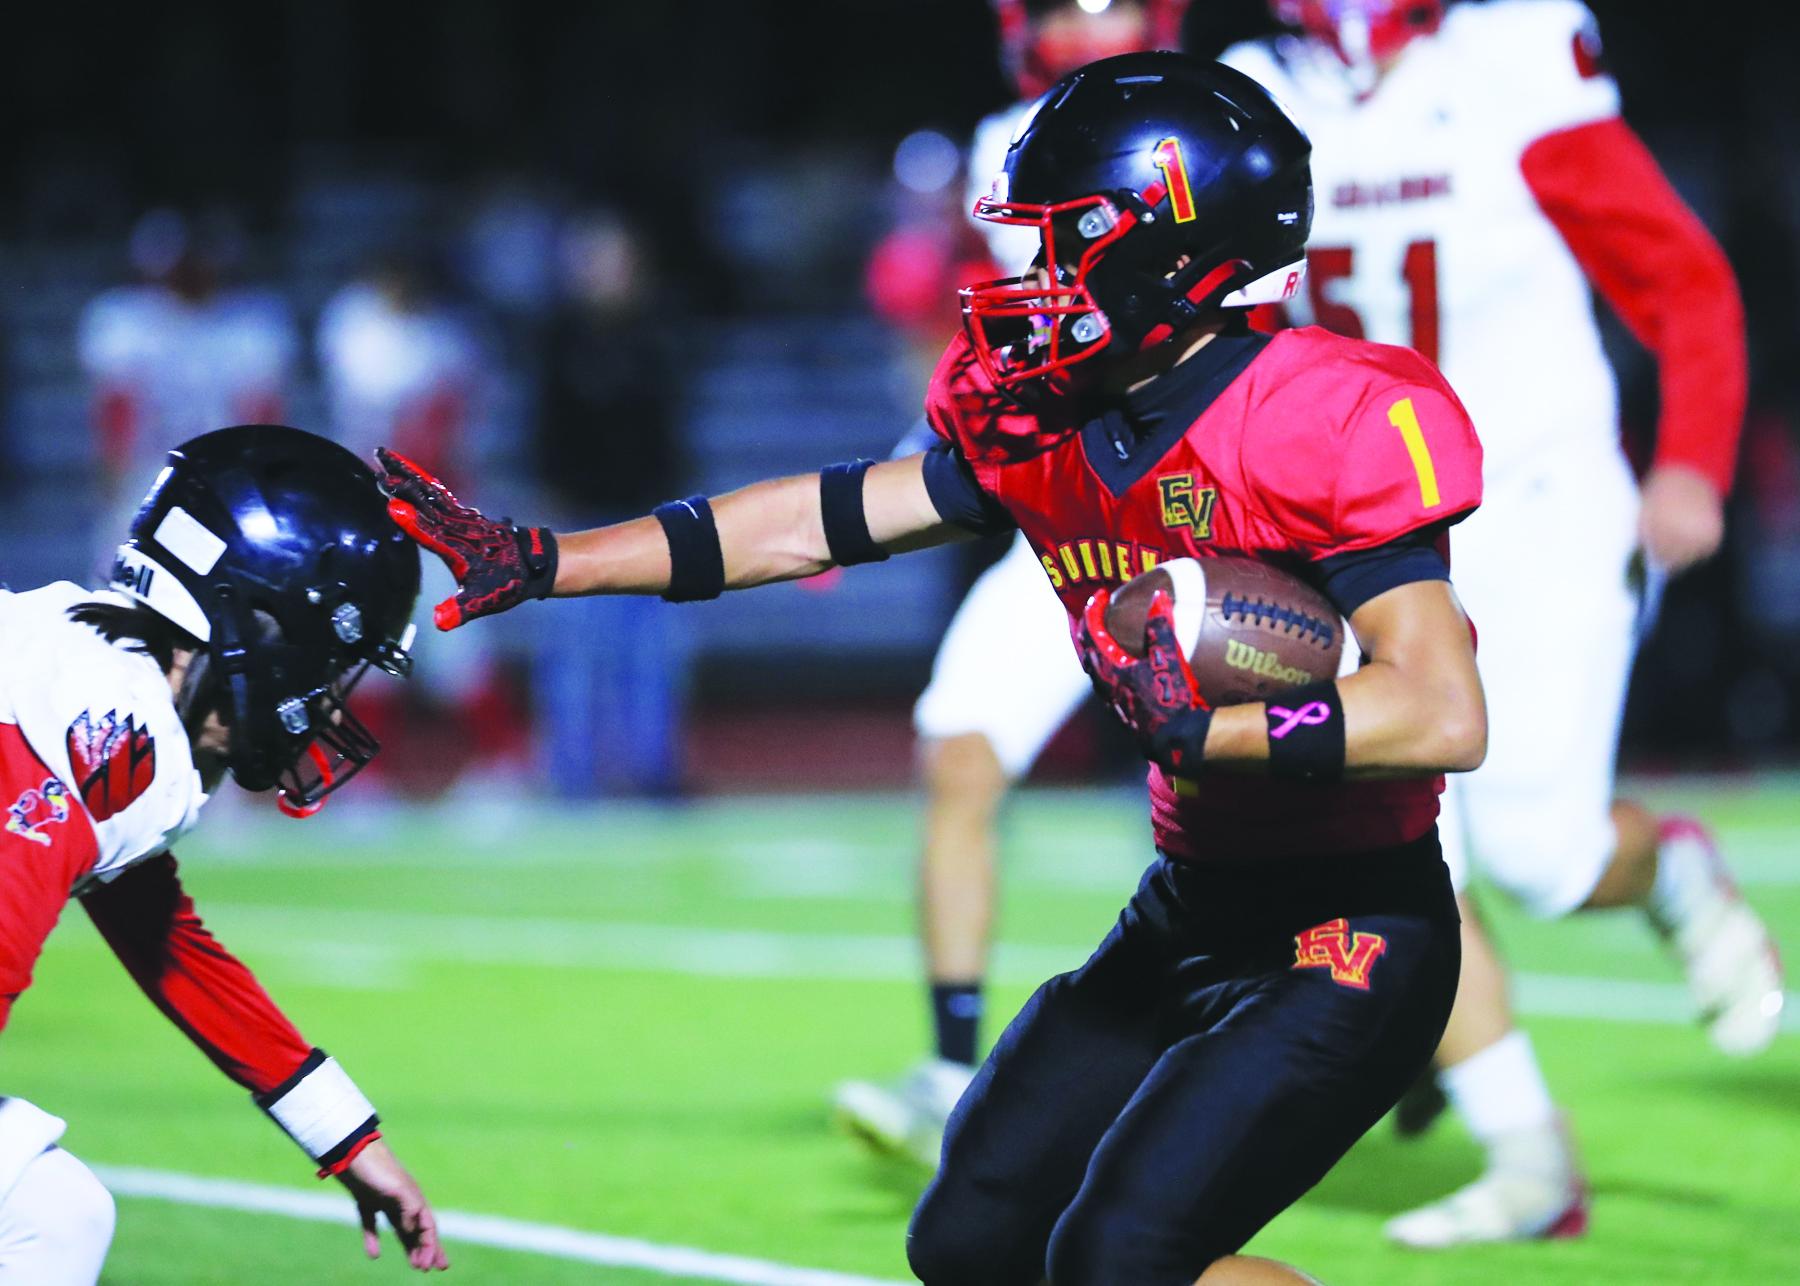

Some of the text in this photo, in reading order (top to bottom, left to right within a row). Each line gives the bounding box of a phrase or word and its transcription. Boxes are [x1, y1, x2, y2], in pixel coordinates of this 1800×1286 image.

[1152, 136, 1196, 224] 1
[1304, 239, 1440, 368] 51
[1387, 397, 1441, 508] 1
[1158, 473, 1217, 539] EV
[1225, 639, 1312, 685] Wilson
[1292, 918, 1387, 990] EV
